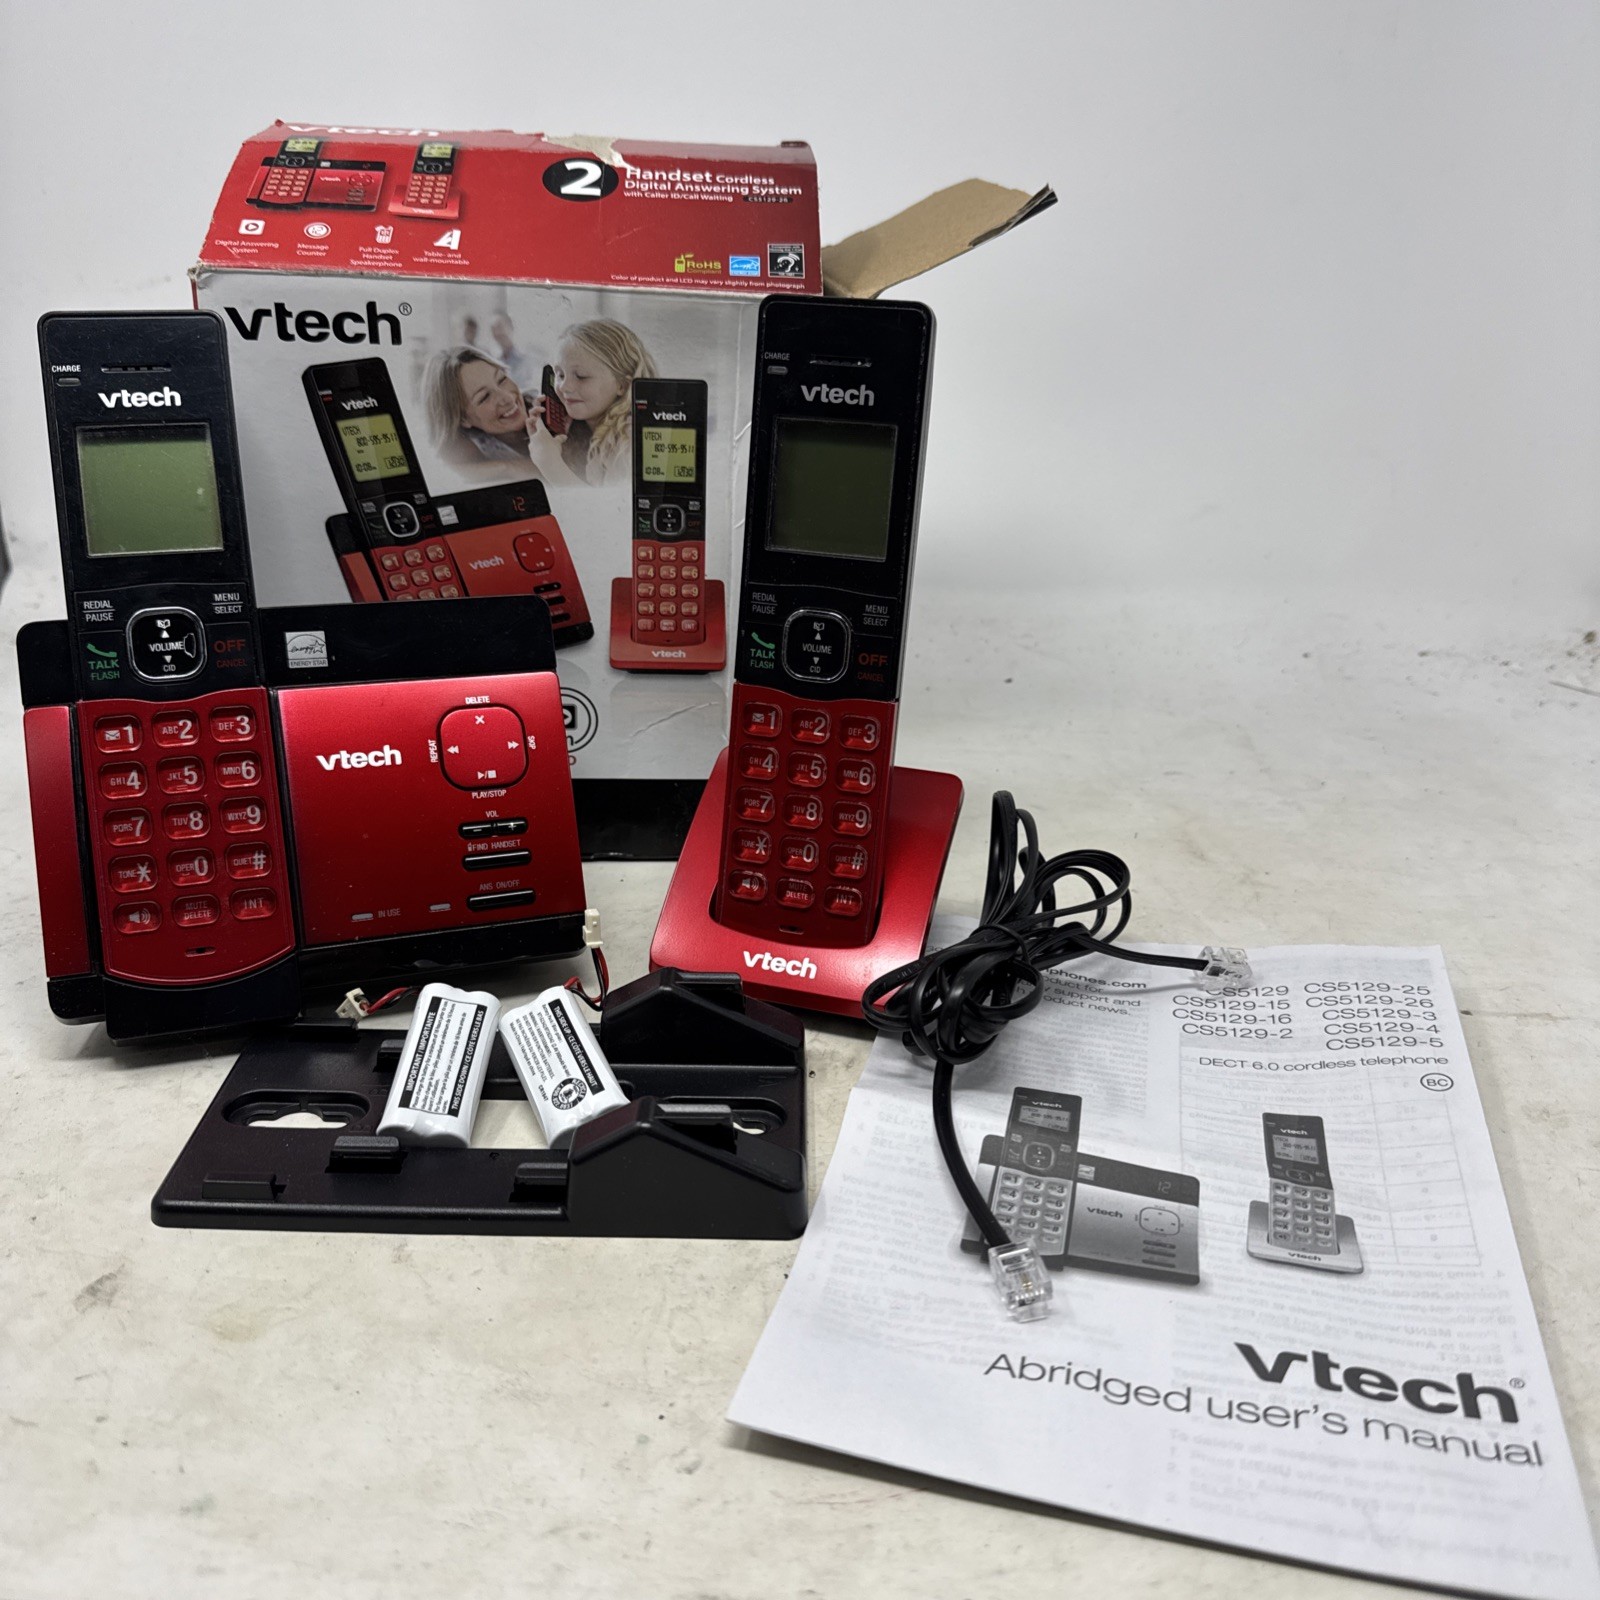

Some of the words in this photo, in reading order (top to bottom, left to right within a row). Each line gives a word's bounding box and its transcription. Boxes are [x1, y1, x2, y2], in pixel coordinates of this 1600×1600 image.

[561, 161, 601, 196] 2
[626, 168, 712, 183] Handset
[716, 175, 774, 185] Cordless
[625, 180, 671, 191] Digital
[675, 182, 749, 195] Answering
[752, 185, 802, 195] System
[701, 194, 733, 202] Waiting
[686, 261, 722, 270] RoHS
[764, 352, 790, 361] CHARGE
[52, 365, 81, 373] CHARGE
[98, 387, 182, 408] vtech
[801, 383, 875, 406] vtech
[341, 397, 378, 410] vtech
[652, 411, 686, 421] vtech
[469, 556, 504, 570] vtech
[83, 600, 113, 609] REDIAL
[214, 593, 240, 602] MENU
[752, 592, 777, 603] REDIAL
[215, 605, 242, 614] SELECT
[752, 605, 776, 615] PAUSE
[865, 604, 888, 615] MENU
[85, 613, 114, 622] PAUSE
[863, 617, 888, 626] SELECT
[148, 642, 184, 652] VOLUME
[213, 639, 246, 653] OFF
[802, 643, 832, 654] VOLUME
[651, 649, 686, 658] vtech
[750, 648, 776, 659] TALK
[858, 652, 888, 666] OFF
[88, 659, 119, 669] TALK
[217, 659, 247, 668] CANCEL
[750, 660, 774, 669] FLASH
[809, 665, 821, 674] CID
[91, 671, 120, 680] FLASH
[857, 672, 885, 682] CANCEL
[465, 695, 490, 705] DELETE
[218, 722, 234, 731] DEF
[236, 715, 250, 735] 3
[768, 711, 776, 730] 1
[813, 716, 826, 736] 2
[123, 724, 134, 744] 1
[162, 725, 178, 735] ABC
[178, 719, 193, 739] 2
[863, 723, 876, 744] 3
[528, 735, 536, 750] SKIP
[428, 738, 438, 763] REPEAT
[316, 744, 402, 772] vtech
[762, 753, 773, 772] 4
[167, 772, 182, 781] JKL
[184, 765, 197, 785] 5
[241, 760, 256, 780] 6
[810, 760, 822, 779] 5
[858, 767, 872, 786] 6
[110, 777, 126, 786] GHI
[126, 770, 141, 790] 4
[472, 789, 506, 799] PLAY/STOP
[760, 795, 772, 813] 7
[227, 811, 246, 821] WXYZ
[246, 804, 261, 825] 9
[485, 810, 499, 818] VOL
[805, 802, 818, 821] 8
[855, 809, 867, 828] 9
[131, 816, 144, 837] 7
[173, 817, 188, 826] TUV
[189, 810, 204, 831] 8
[472, 842, 488, 851] FIND
[491, 839, 521, 850] HANDSET
[802, 844, 815, 862] 0
[176, 863, 194, 873] OPER
[194, 856, 208, 876] 0
[234, 857, 252, 866] QUIET
[480, 882, 493, 890] ANS
[496, 880, 520, 889] ON/OFF
[786, 890, 808, 900] DELETE
[244, 898, 264, 910] INT
[184, 909, 212, 920] DELETE
[378, 910, 385, 918] IN
[387, 908, 400, 917] USE
[743, 950, 817, 979] vtech
[1054, 988, 1109, 1003] support
[1084, 984, 1103, 993] for
[1304, 982, 1431, 996] CS5129-25
[1089, 1003, 1131, 1015] news.
[1172, 995, 1290, 1011] CS5129-15
[1306, 995, 1434, 1009] CS5129-26
[1172, 1008, 1292, 1025] CS5129-16
[1322, 1008, 1437, 1021] CS5129-3
[1182, 1023, 1293, 1040] CS5129-2
[1324, 1022, 1441, 1035] CS5129-4
[1326, 1036, 1444, 1050] CS5129-5
[405, 1052, 423, 1091] IMPORTANT
[418, 1011, 435, 1050] IMPORTANTE
[1199, 1057, 1248, 1069] DECT
[1253, 1061, 1279, 1071] 6.0
[1284, 1057, 1356, 1072] cordless
[1360, 1055, 1449, 1067] telephone
[1425, 1078, 1449, 1087] BC
[1087, 1206, 1123, 1219] vtech
[1288, 1252, 1321, 1261] vtech
[983, 1353, 1193, 1413] Abridged
[1363, 1415, 1545, 1467] manual
